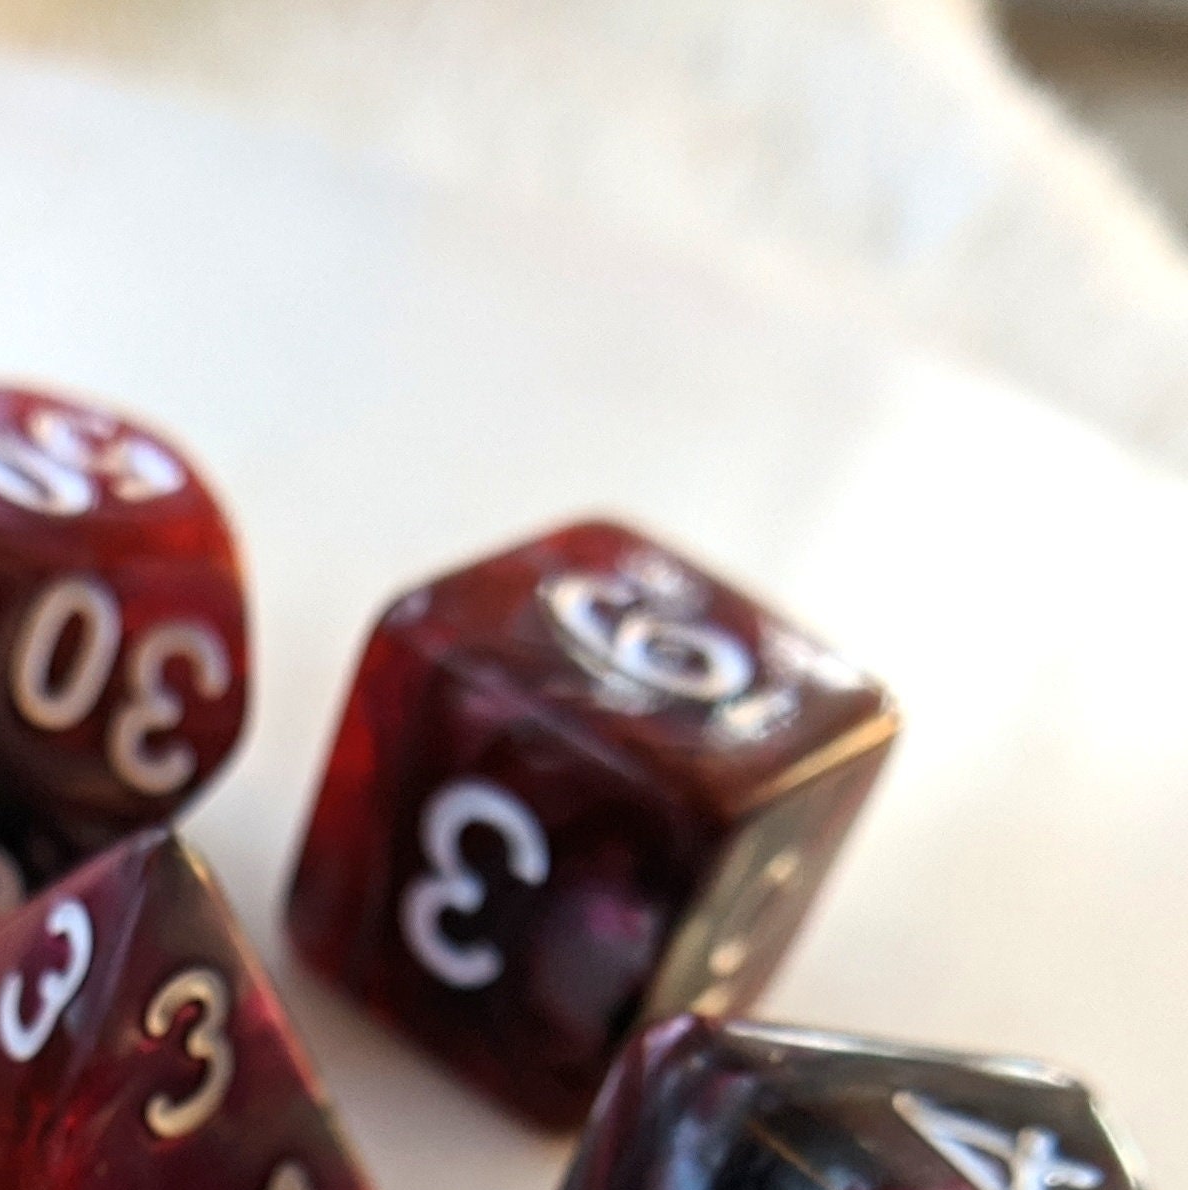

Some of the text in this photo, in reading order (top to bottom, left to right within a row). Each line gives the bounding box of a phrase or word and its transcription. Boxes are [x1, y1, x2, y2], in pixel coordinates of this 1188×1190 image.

[13, 575, 230, 797] 30
[399, 781, 551, 990] 3
[145, 968, 236, 1140] 3
